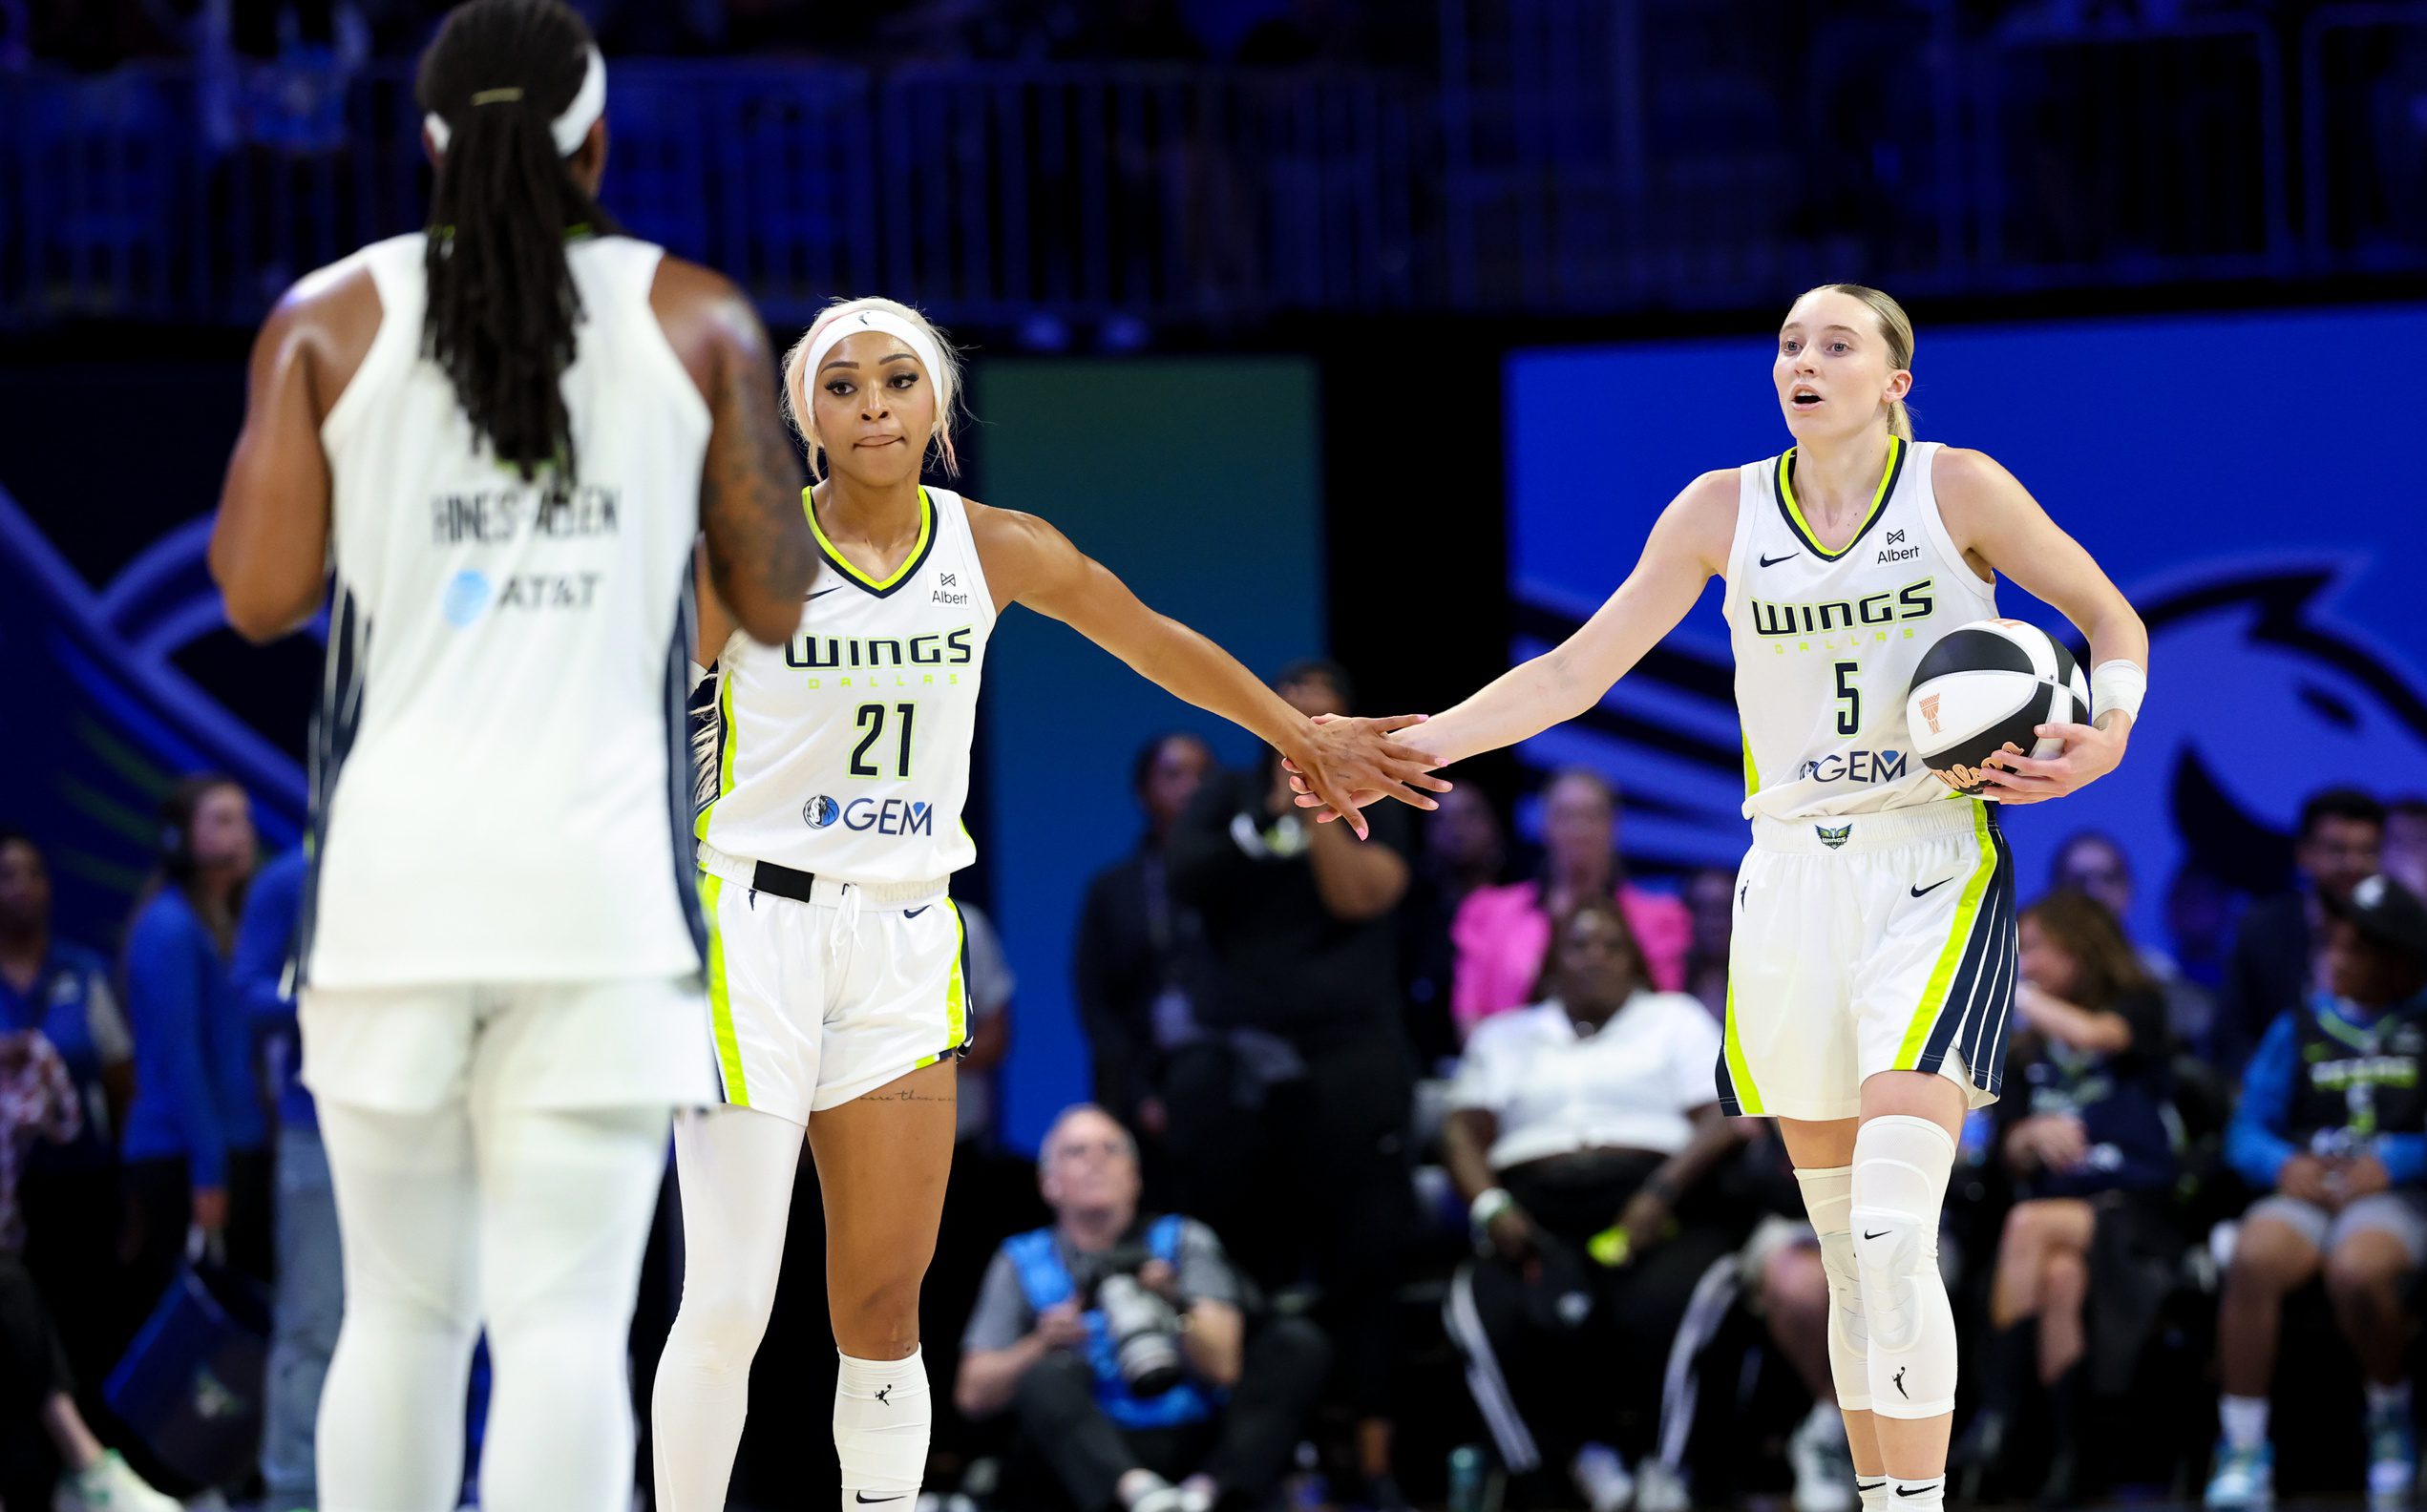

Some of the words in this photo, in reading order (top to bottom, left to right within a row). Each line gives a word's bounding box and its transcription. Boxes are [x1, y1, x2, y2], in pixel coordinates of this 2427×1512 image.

[1877, 545, 1920, 565] Albert
[497, 573, 600, 611] AT&T
[932, 591, 968, 605] Albert
[1752, 578, 1935, 637] WINGS
[784, 625, 972, 670] WINGS
[1775, 628, 1914, 655] DALLAS
[808, 674, 958, 689] DALLAS
[1832, 659, 1863, 738] 5
[847, 700, 918, 780] 21
[1813, 750, 1908, 783] GEM
[843, 797, 933, 836] GEM
